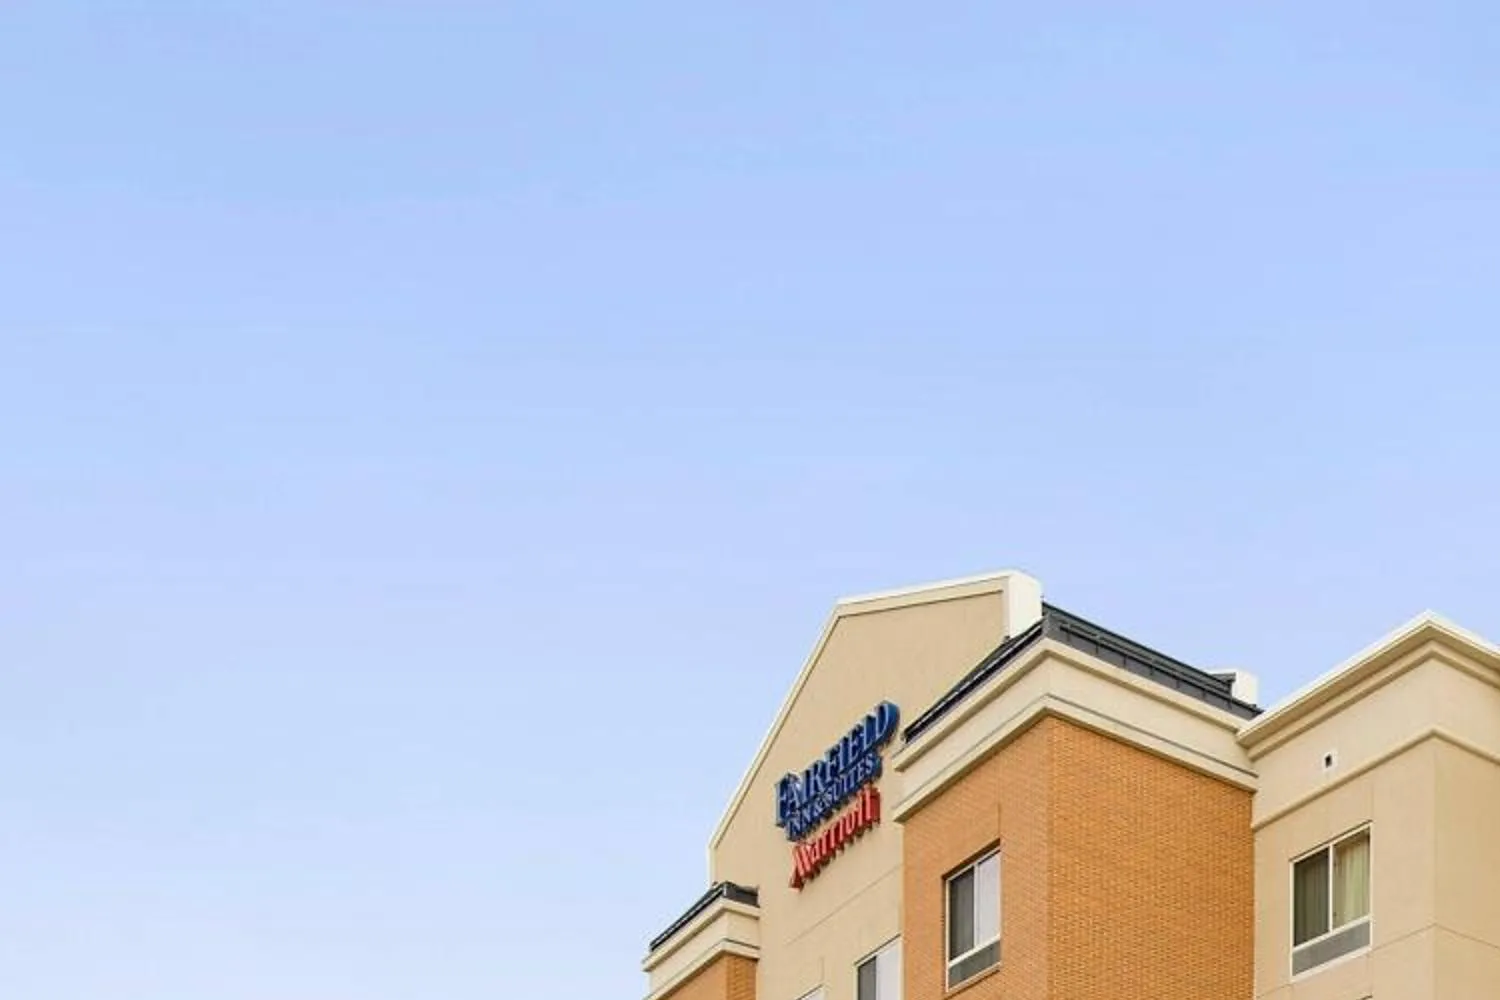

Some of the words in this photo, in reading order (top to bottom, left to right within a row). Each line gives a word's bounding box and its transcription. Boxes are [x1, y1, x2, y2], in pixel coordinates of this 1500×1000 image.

[775, 700, 900, 828] FAIRFIELD
[823, 752, 882, 808] SUITES
[789, 781, 881, 891] Marriott
